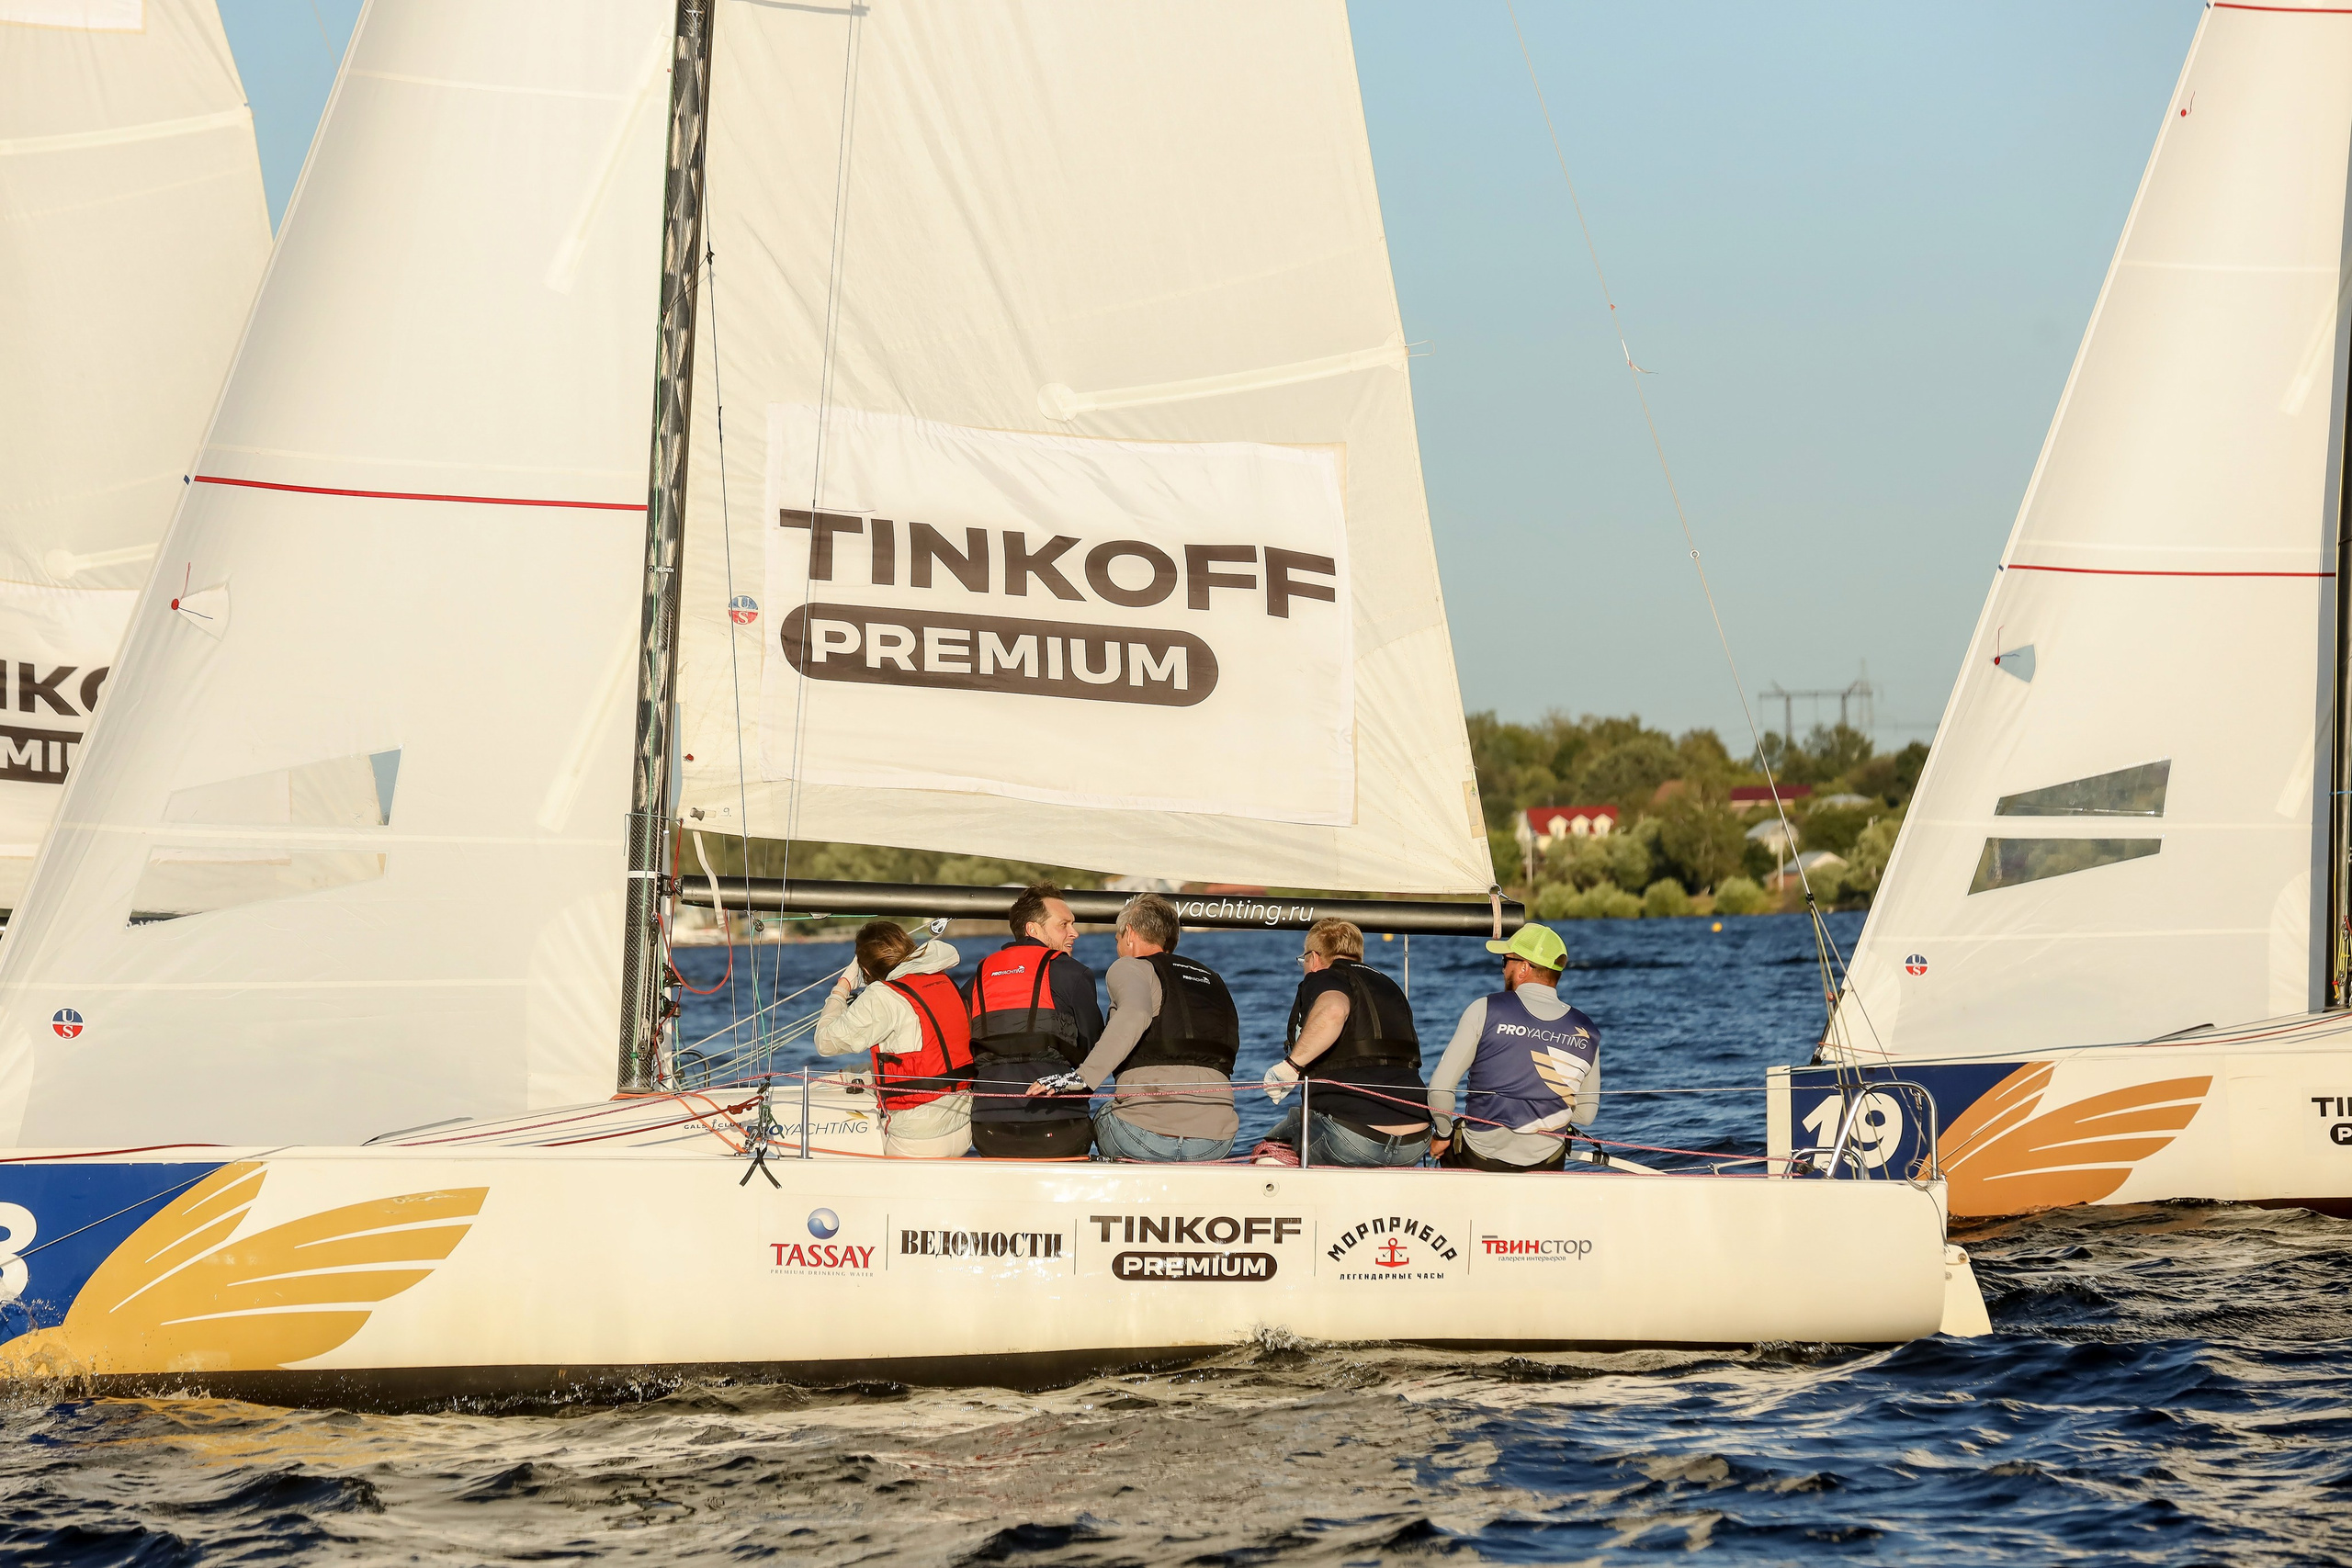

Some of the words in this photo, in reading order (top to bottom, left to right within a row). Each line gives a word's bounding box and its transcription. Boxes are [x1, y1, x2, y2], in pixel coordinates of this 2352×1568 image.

[780, 508, 1336, 619] TINKOFF
[808, 618, 1190, 691] PREMIUM
[1125, 898, 1314, 926] yachting.ru
[1497, 1023, 1589, 1050] PROYACHTING
[2312, 1097, 2352, 1117] TI
[747, 1122, 869, 1136] OYACHTING
[1802, 1092, 1904, 1169] 19
[899, 1229, 1064, 1259] ВЕДОМОСТИ
[1090, 1215, 1303, 1245] TINKOFF
[1327, 1216, 1458, 1263] МОРПРИБОР
[769, 1243, 876, 1269] TASSAY
[1122, 1256, 1267, 1277] PREMIUM
[1340, 1272, 1413, 1280] ЛЕГЕНДАРНЫЕ
